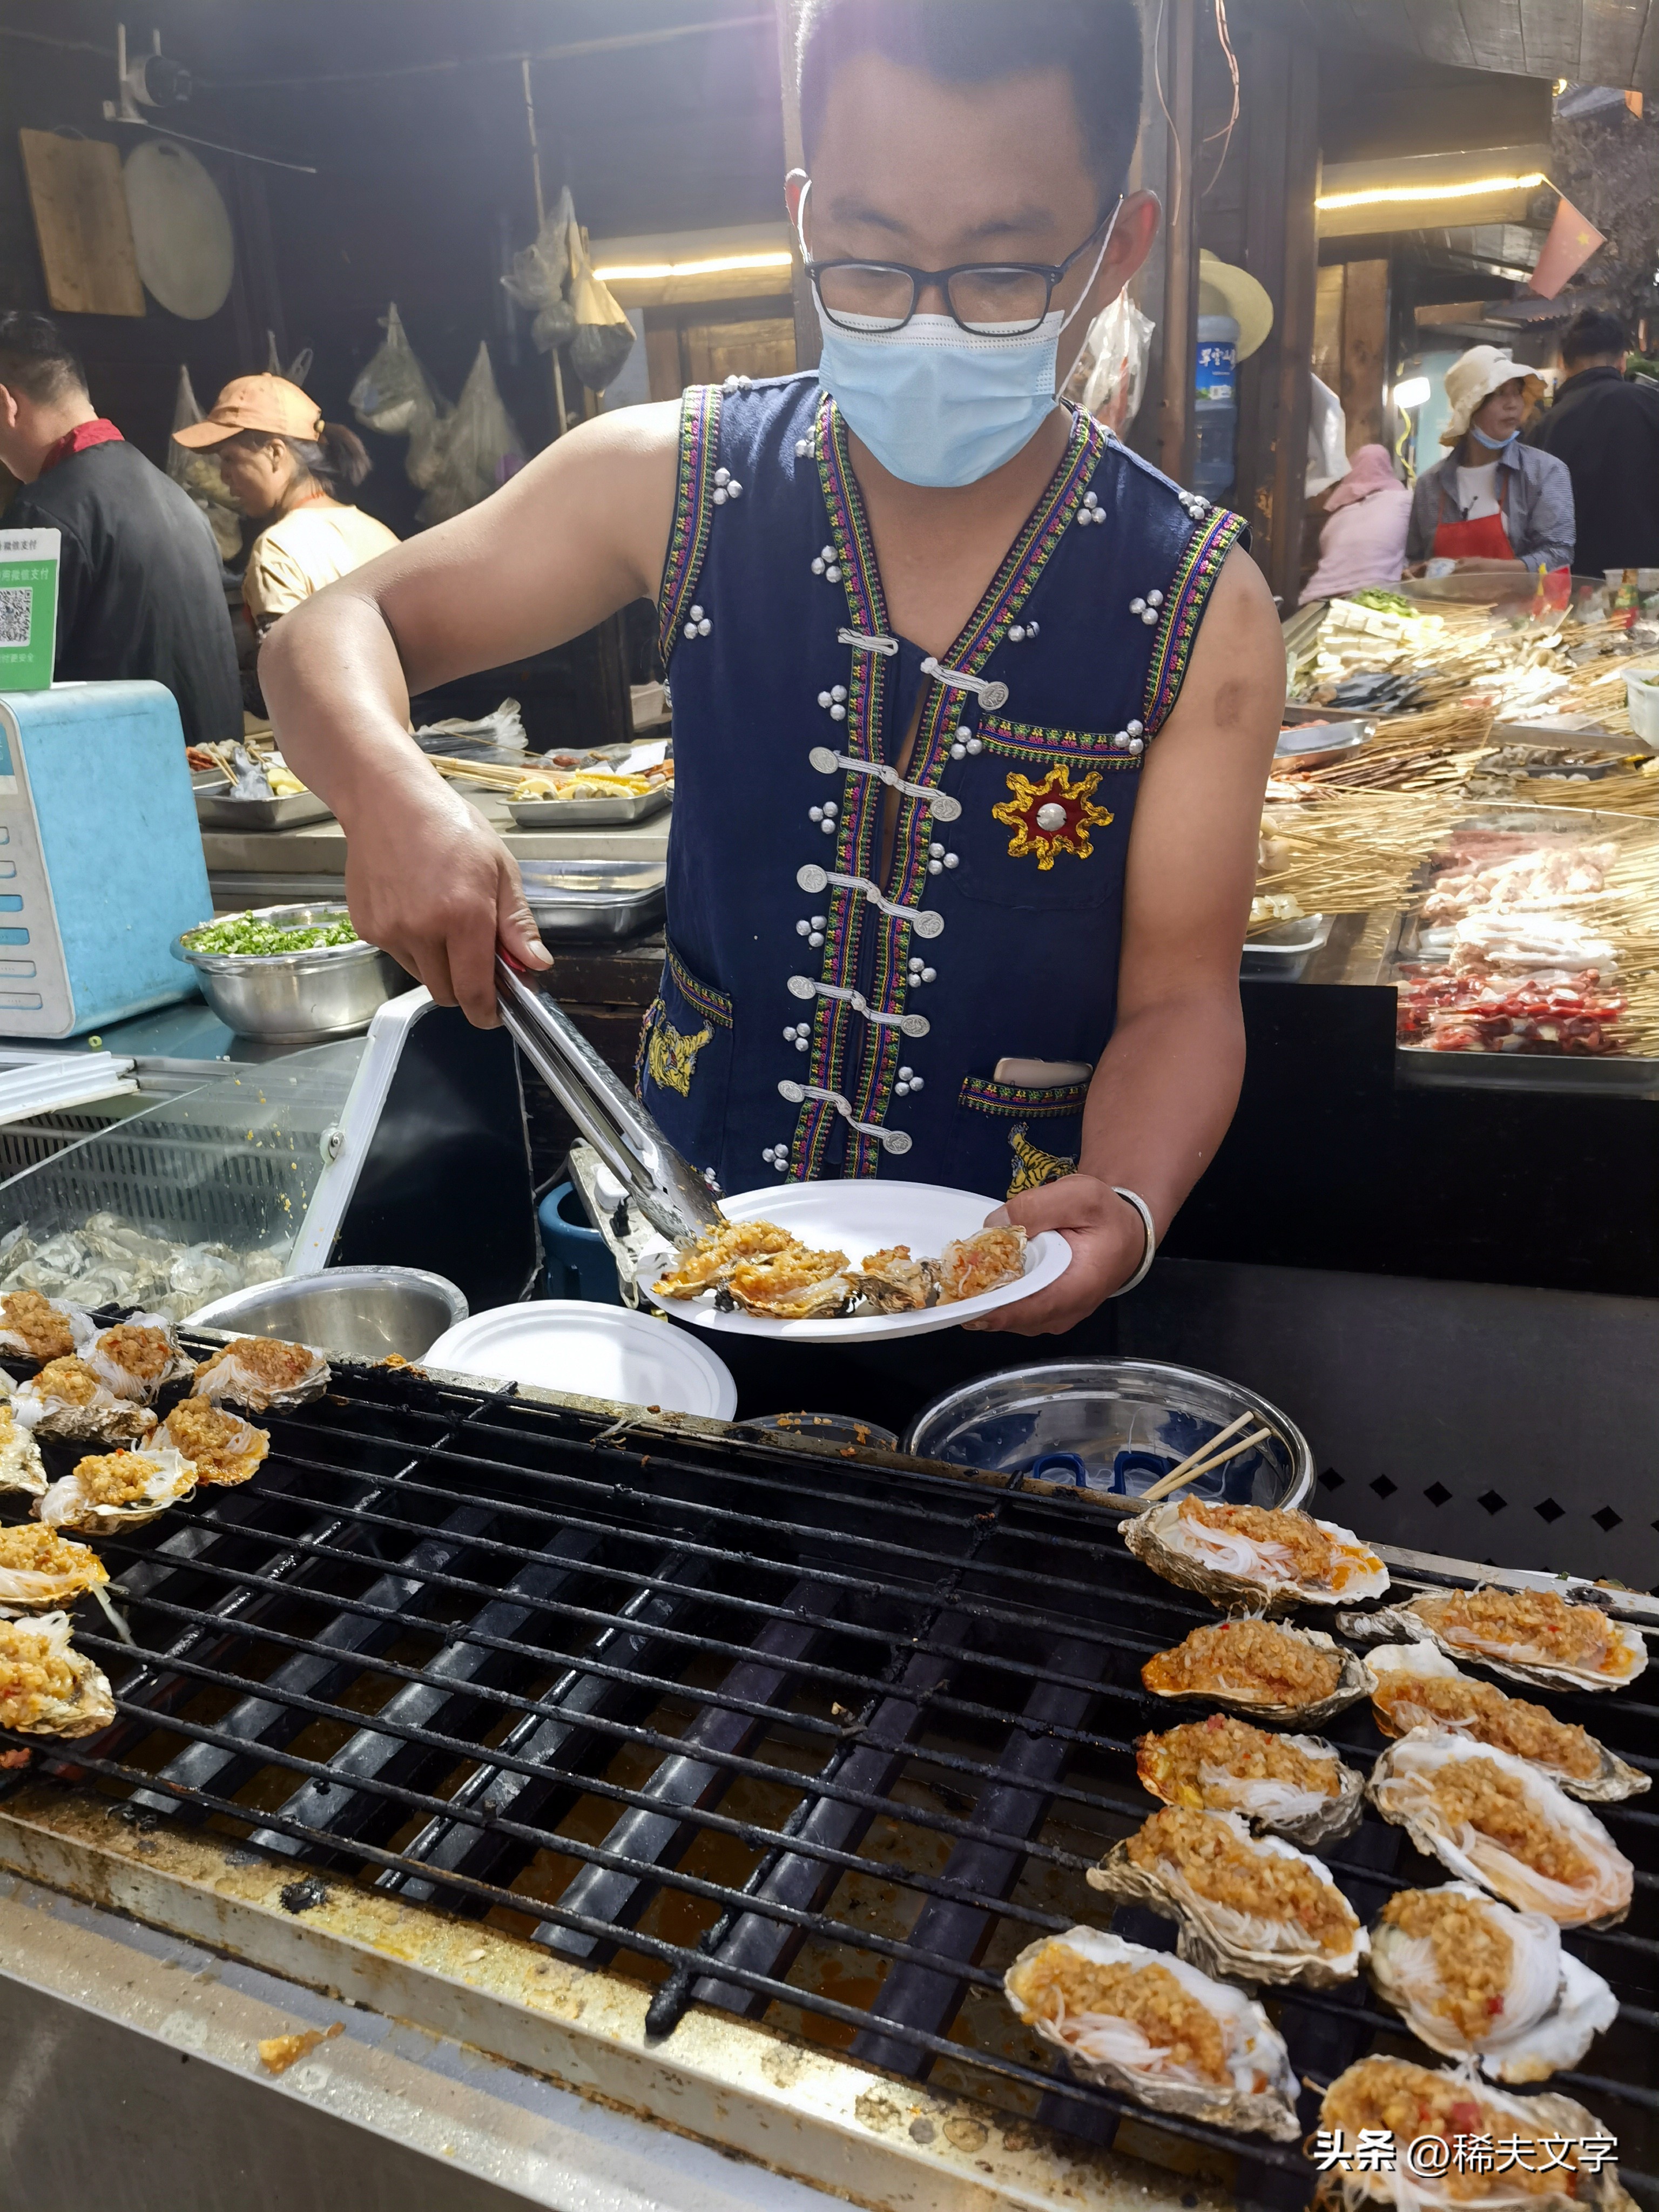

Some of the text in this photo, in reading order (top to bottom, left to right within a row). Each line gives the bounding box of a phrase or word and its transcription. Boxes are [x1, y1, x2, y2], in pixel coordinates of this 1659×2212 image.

[0, 539, 37, 550] 微信支付
[0, 567, 49, 582] 用微信支付
[0, 652, 33, 663] 付更安全
